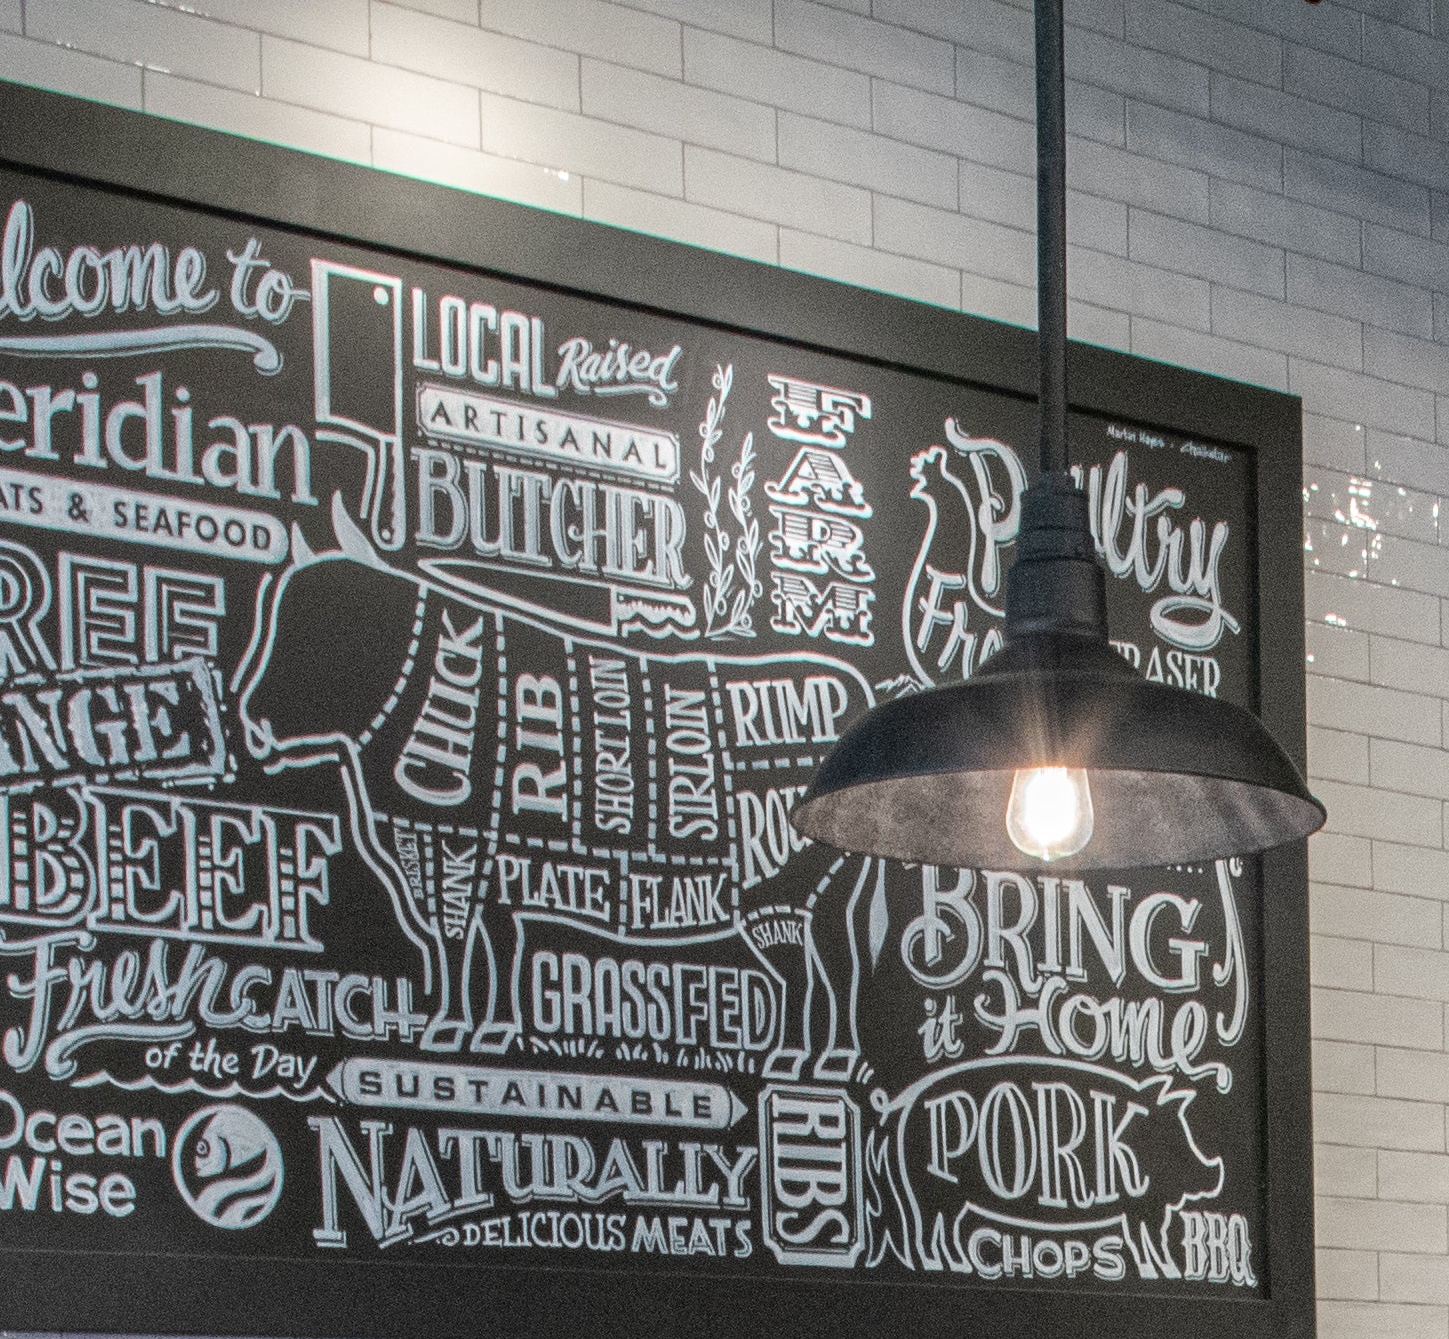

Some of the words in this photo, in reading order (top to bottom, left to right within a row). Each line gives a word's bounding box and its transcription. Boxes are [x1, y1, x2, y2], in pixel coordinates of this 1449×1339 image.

[227, 239, 310, 324] to
[412, 287, 557, 396] LOCAL
[556, 337, 681, 406] Raised
[430, 400, 670, 474] ARTISANAL
[67, 494, 90, 524] &
[111, 499, 273, 553] SEAFOOD
[410, 447, 692, 589] BUTCHER
[766, 374, 874, 647] FARM
[394, 608, 485, 806] CHUCK
[511, 672, 568, 821] RIB
[725, 676, 849, 747] RUMP
[664, 683, 719, 841] SIRLOIN
[393, 825, 422, 900] BRISKET
[441, 840, 479, 940] SHANK
[495, 853, 611, 922] PLATE
[629, 873, 731, 930] FLANK
[752, 919, 805, 949] SHANK
[901, 861, 1201, 989] BRING
[231, 966, 429, 1043] CATCH
[918, 997, 964, 1061] it
[975, 972, 1231, 1094] Home
[146, 1044, 181, 1072] of
[188, 1042, 240, 1076] the
[252, 1046, 320, 1089] Day
[356, 1068, 713, 1121] SUSTAINABLE
[306, 1116, 758, 1250] NATURALLY
[770, 1099, 850, 1248] RIBS
[925, 1081, 1151, 1210] PORK
[462, 1208, 626, 1252] DELICIOUS
[631, 1216, 753, 1259] MEATS
[967, 1227, 1127, 1281] CHOPS
[1182, 1210, 1258, 1287] BBQ
